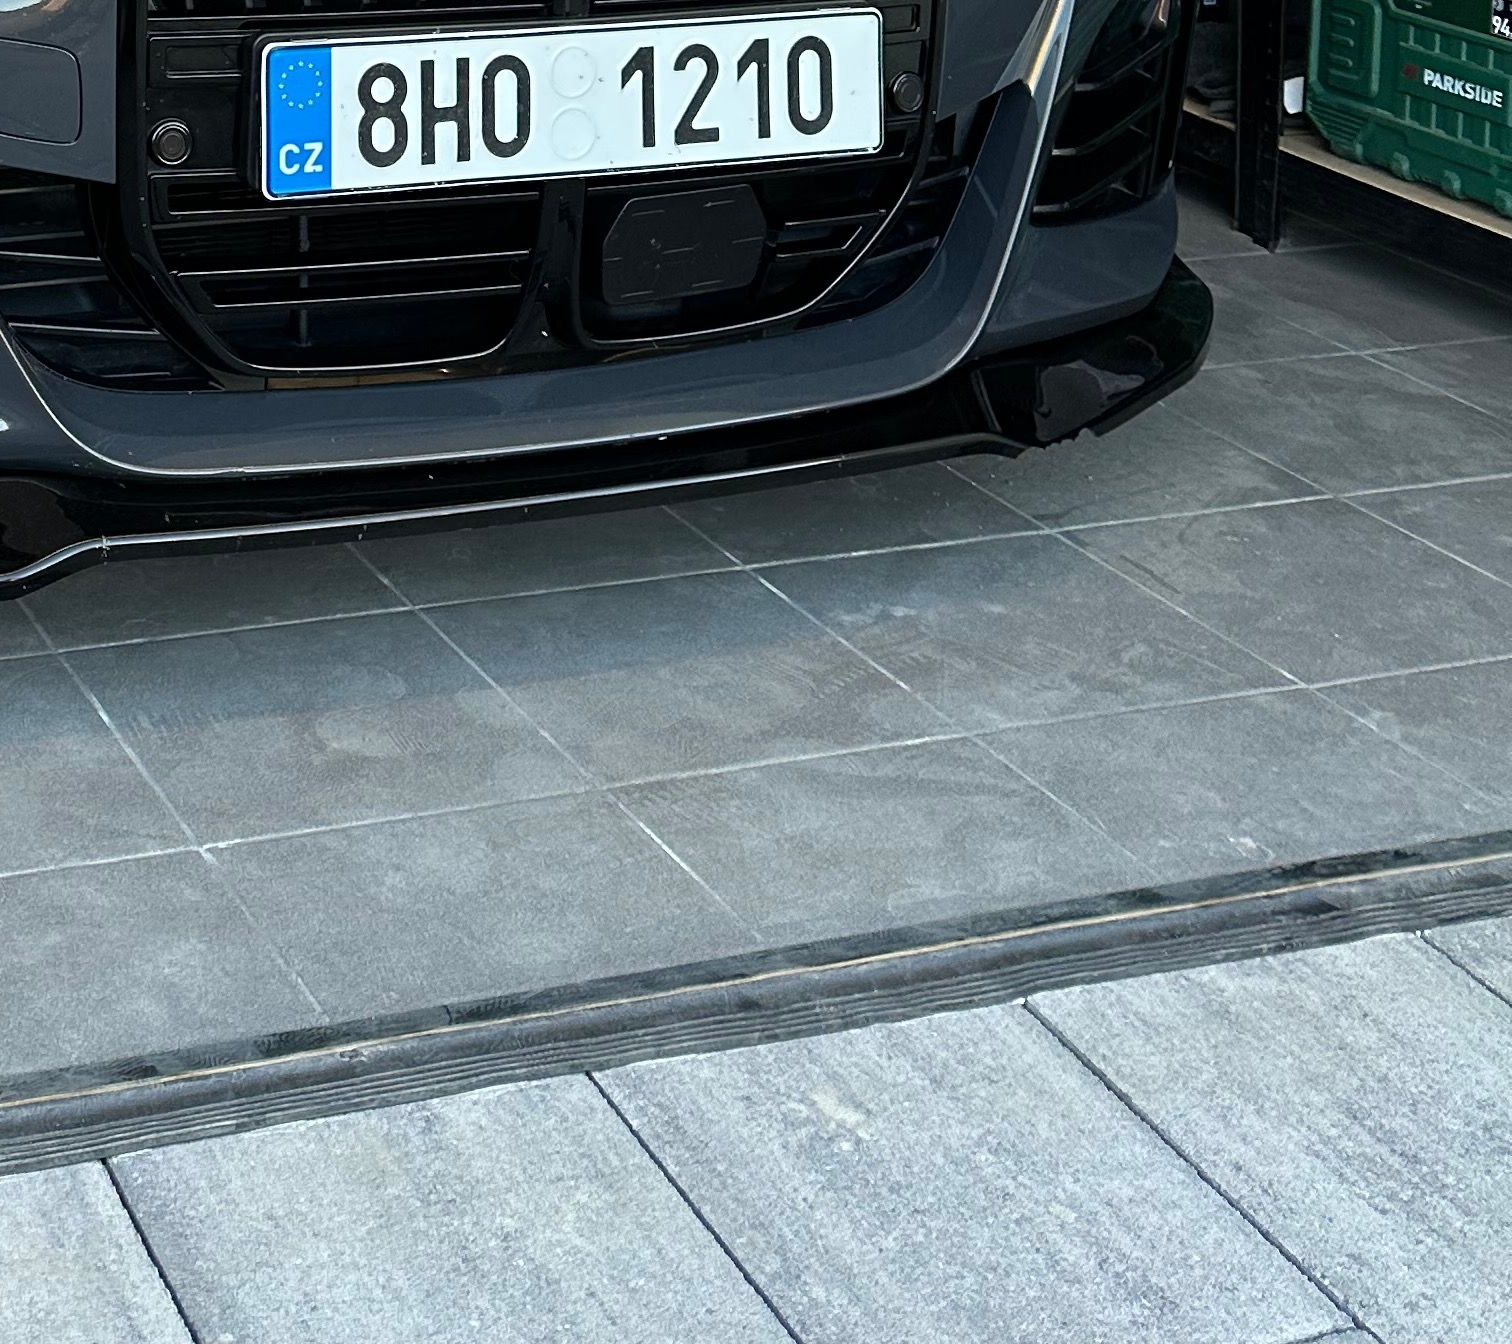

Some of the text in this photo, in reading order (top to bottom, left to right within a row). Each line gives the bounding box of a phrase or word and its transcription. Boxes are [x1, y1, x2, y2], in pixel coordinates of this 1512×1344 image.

[357, 35, 834, 169] 8H0 1210
[1423, 68, 1503, 108] PARKSIDE
[278, 141, 324, 176] CZ
